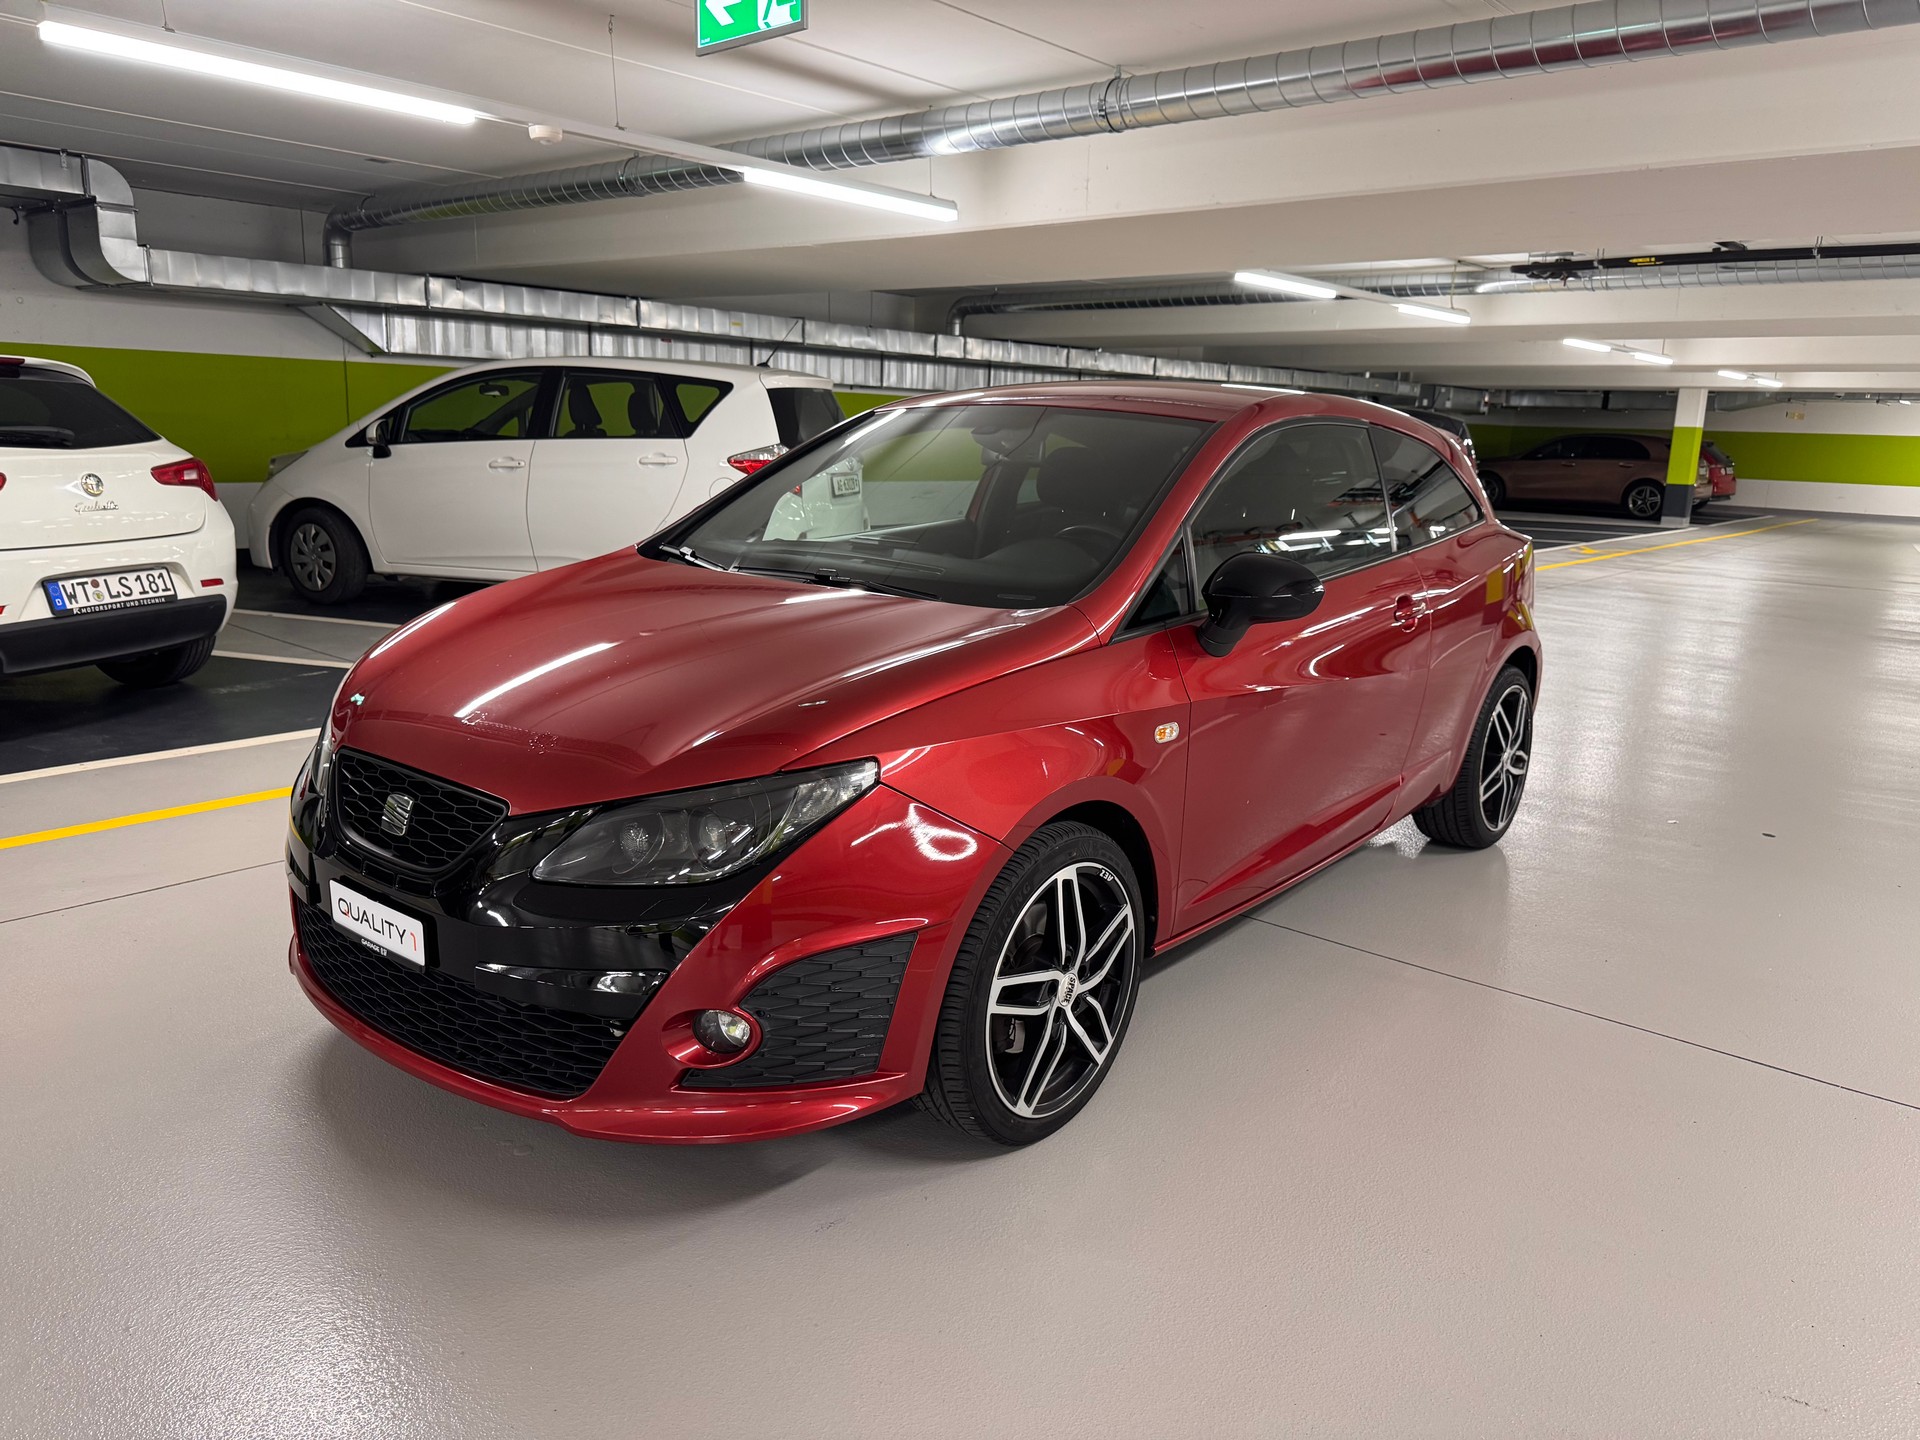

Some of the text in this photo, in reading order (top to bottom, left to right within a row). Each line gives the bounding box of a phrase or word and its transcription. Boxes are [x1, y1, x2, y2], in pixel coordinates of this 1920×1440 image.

[61, 572, 172, 605] WT LS 181
[82, 603, 124, 613] MOTORSPORT
[140, 597, 166, 606] TECHNIK
[1100, 868, 1114, 881] AEZ
[338, 897, 417, 952] QUALITY 1
[1063, 976, 1076, 1004] SPACE
